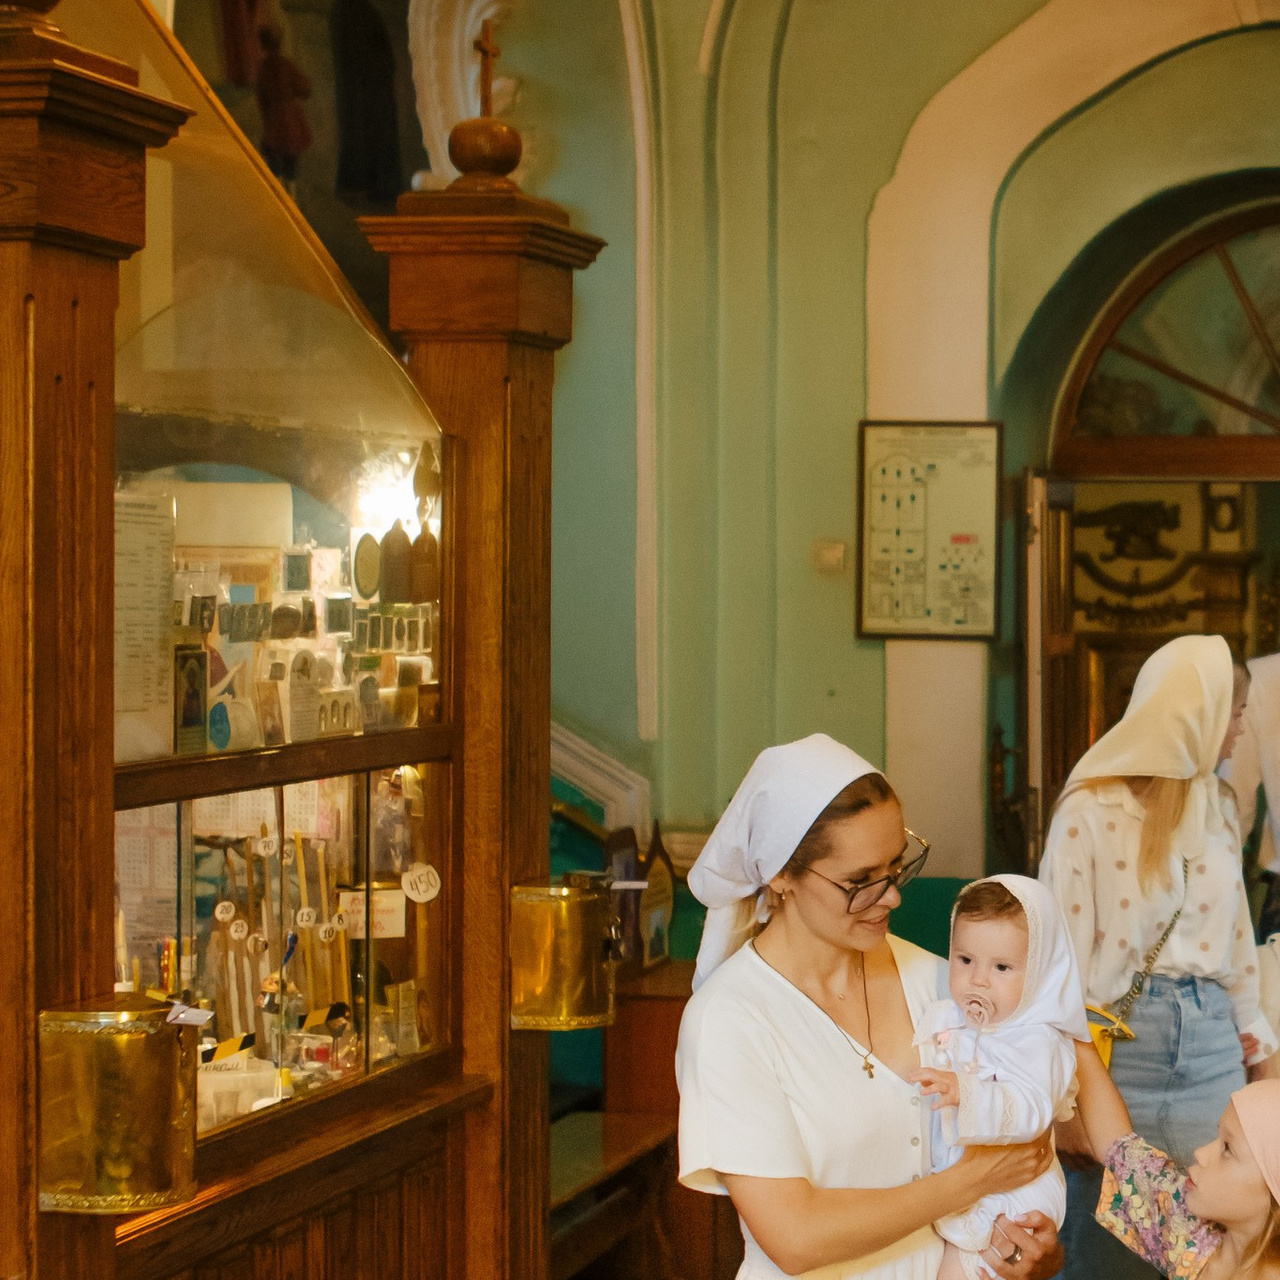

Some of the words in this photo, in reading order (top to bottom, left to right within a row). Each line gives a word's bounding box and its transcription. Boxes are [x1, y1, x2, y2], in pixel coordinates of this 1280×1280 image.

[409, 870, 438, 896] 450
[219, 904, 233, 915] 20
[300, 911, 311, 923] 15
[337, 913, 344, 925] 8
[323, 926, 335, 939] 10
